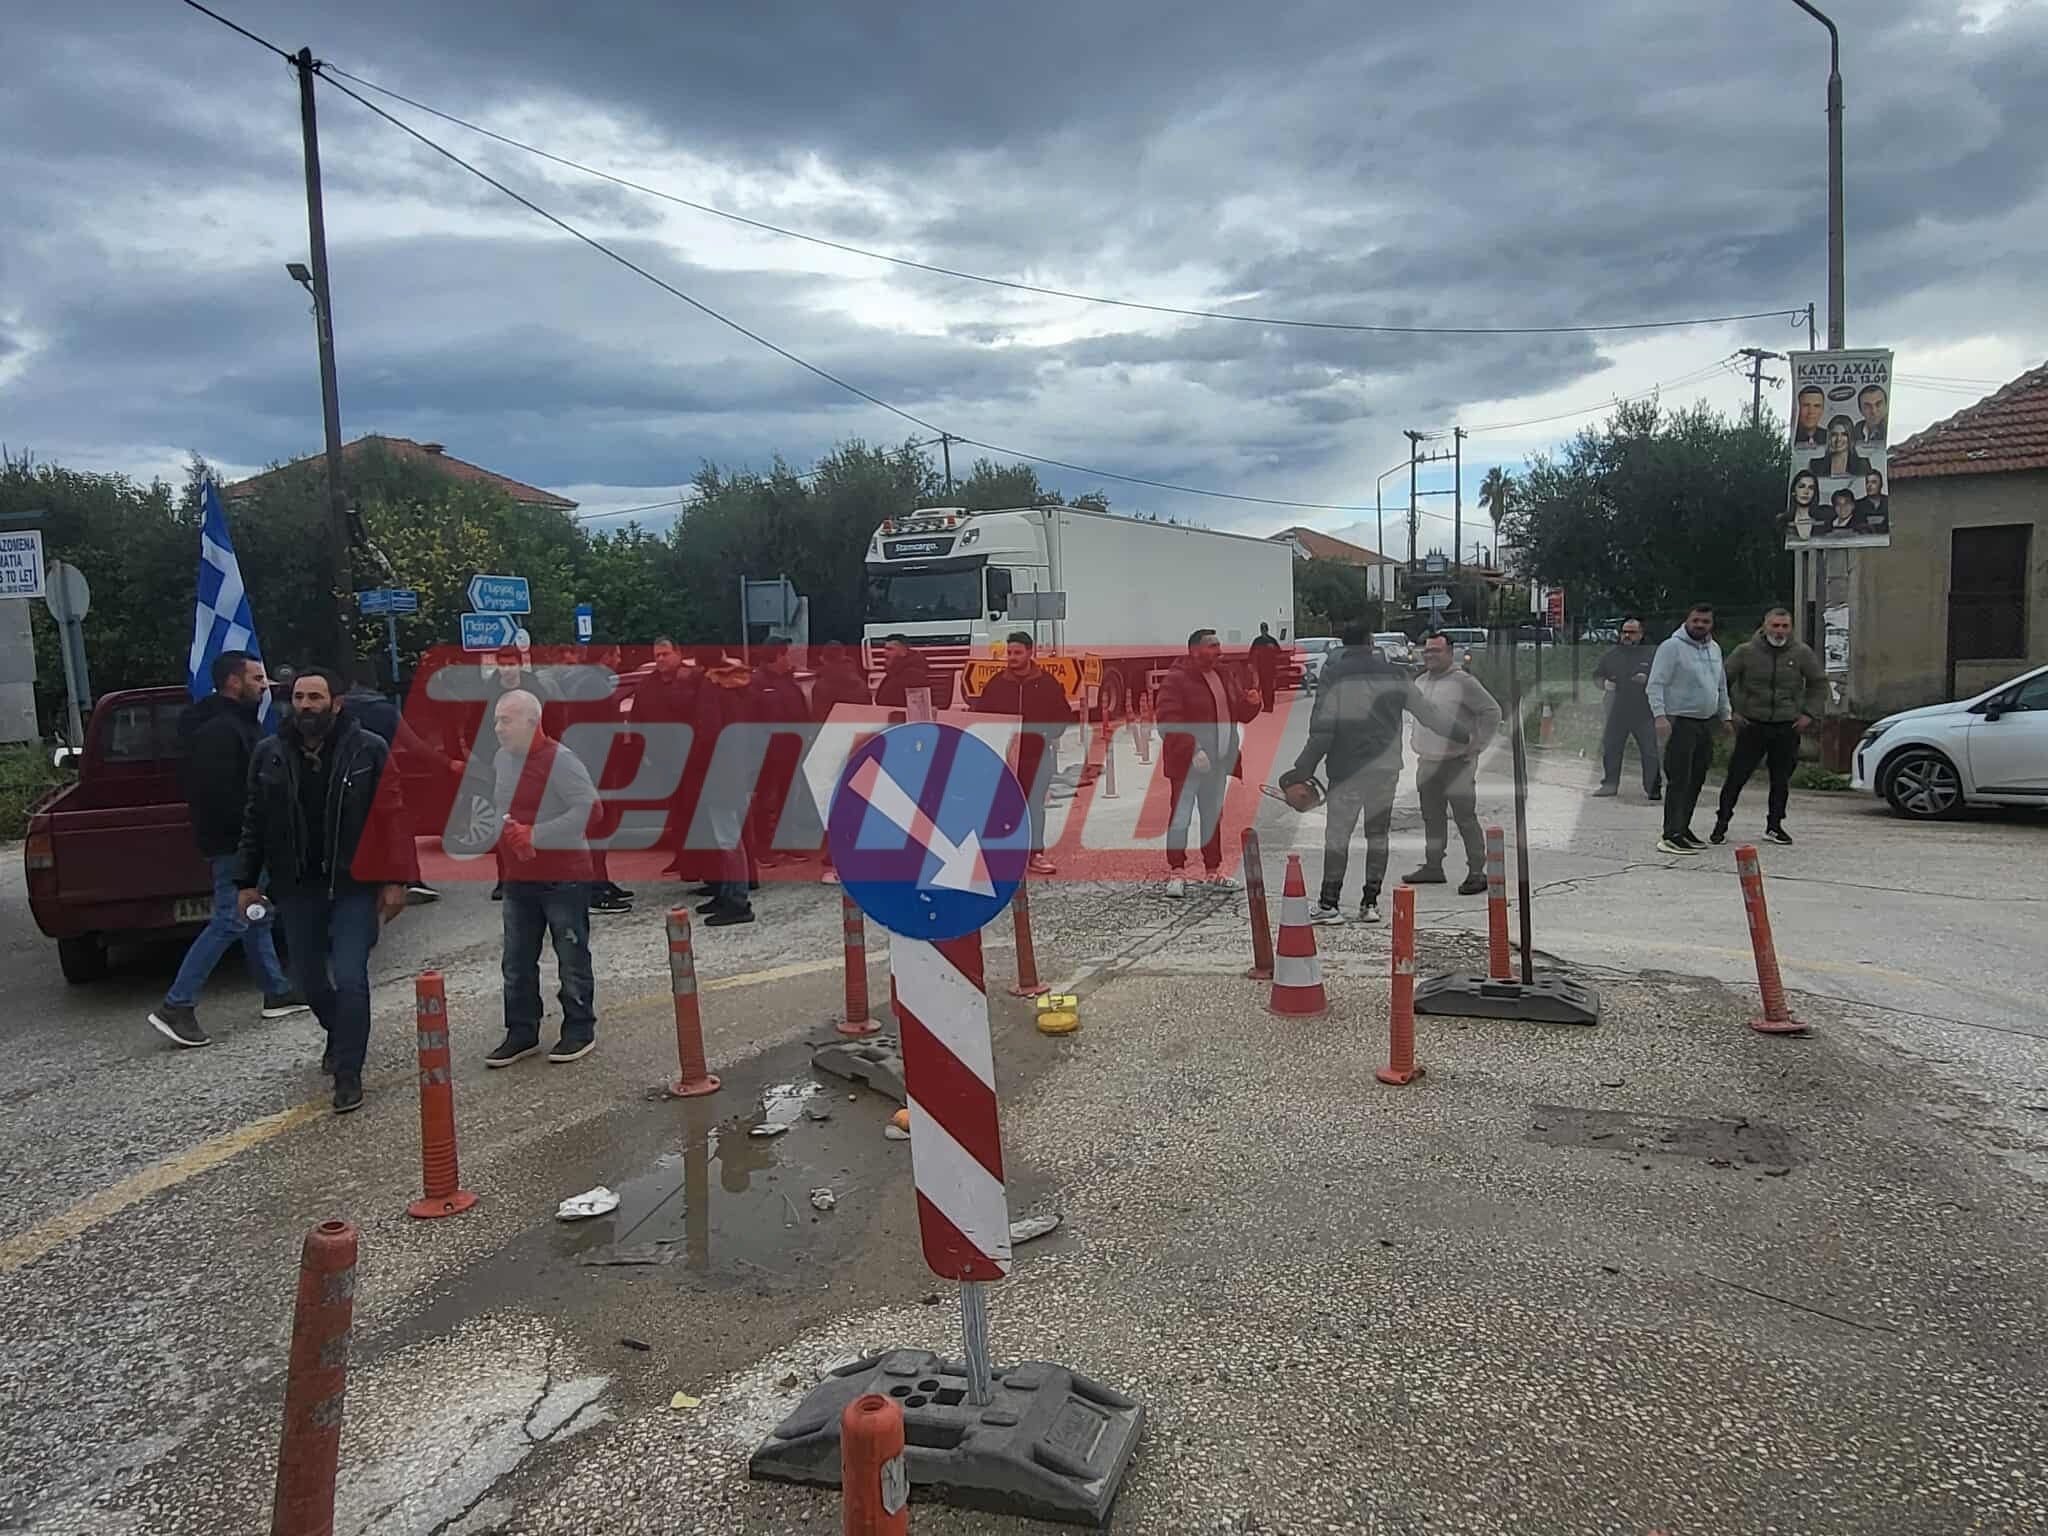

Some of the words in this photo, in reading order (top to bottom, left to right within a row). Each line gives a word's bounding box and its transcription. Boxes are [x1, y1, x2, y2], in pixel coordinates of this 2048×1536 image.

[1797, 363, 1838, 376] ΚΑΤΩ
[1842, 359, 1888, 375] ΑΧΑΪΑ
[6, 570, 16, 583] TO
[19, 568, 32, 582] LET
